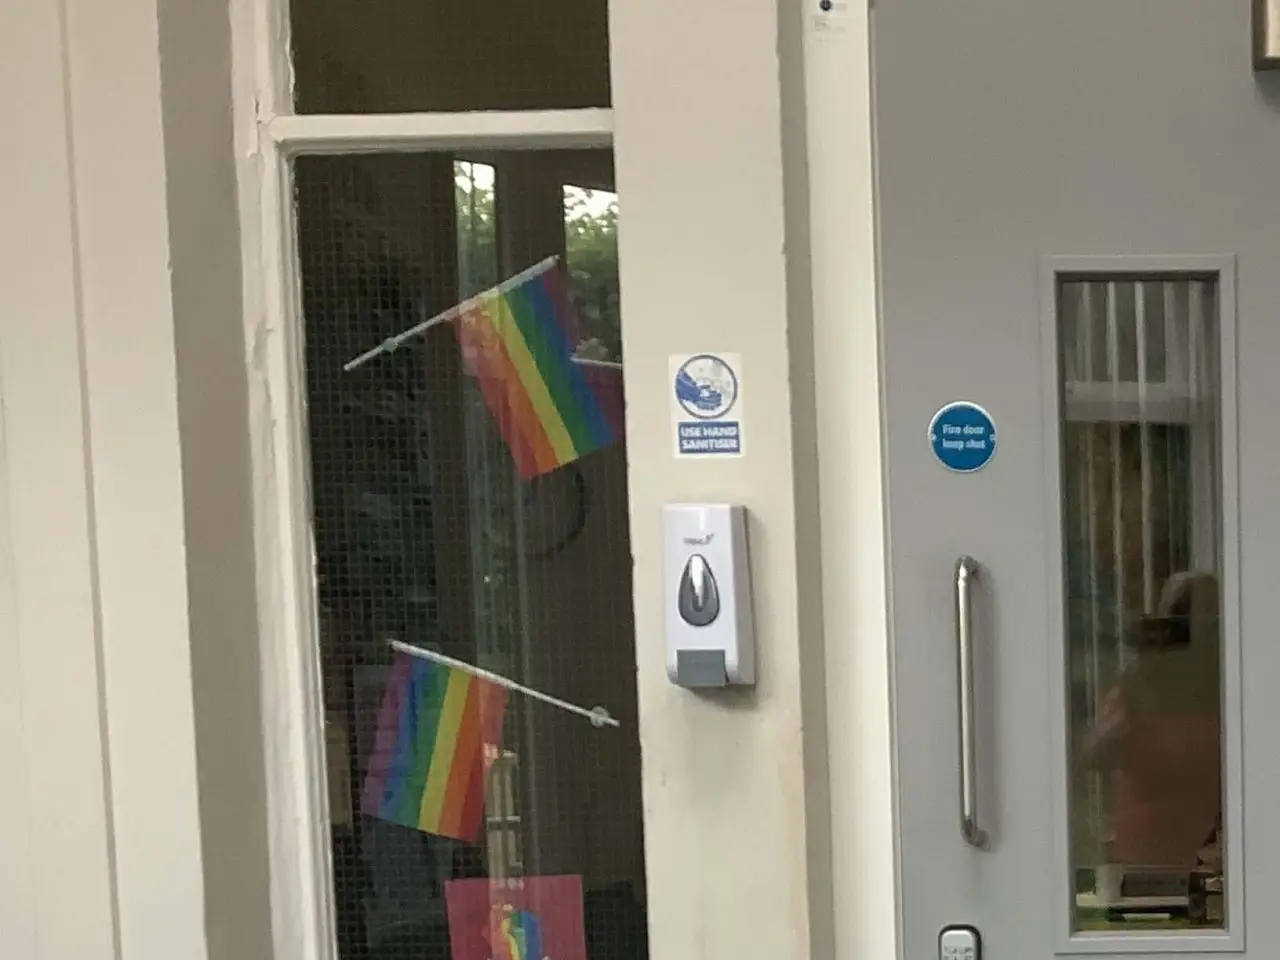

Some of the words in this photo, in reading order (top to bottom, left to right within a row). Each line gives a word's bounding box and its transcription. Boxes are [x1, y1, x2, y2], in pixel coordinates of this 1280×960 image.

[680, 427, 701, 436] USE
[703, 427, 737, 437] HAND
[942, 424, 961, 434] Fire
[963, 424, 985, 434] door
[682, 440, 738, 449] SANITISER
[942, 439, 964, 451] keep
[965, 440, 986, 449] shut
